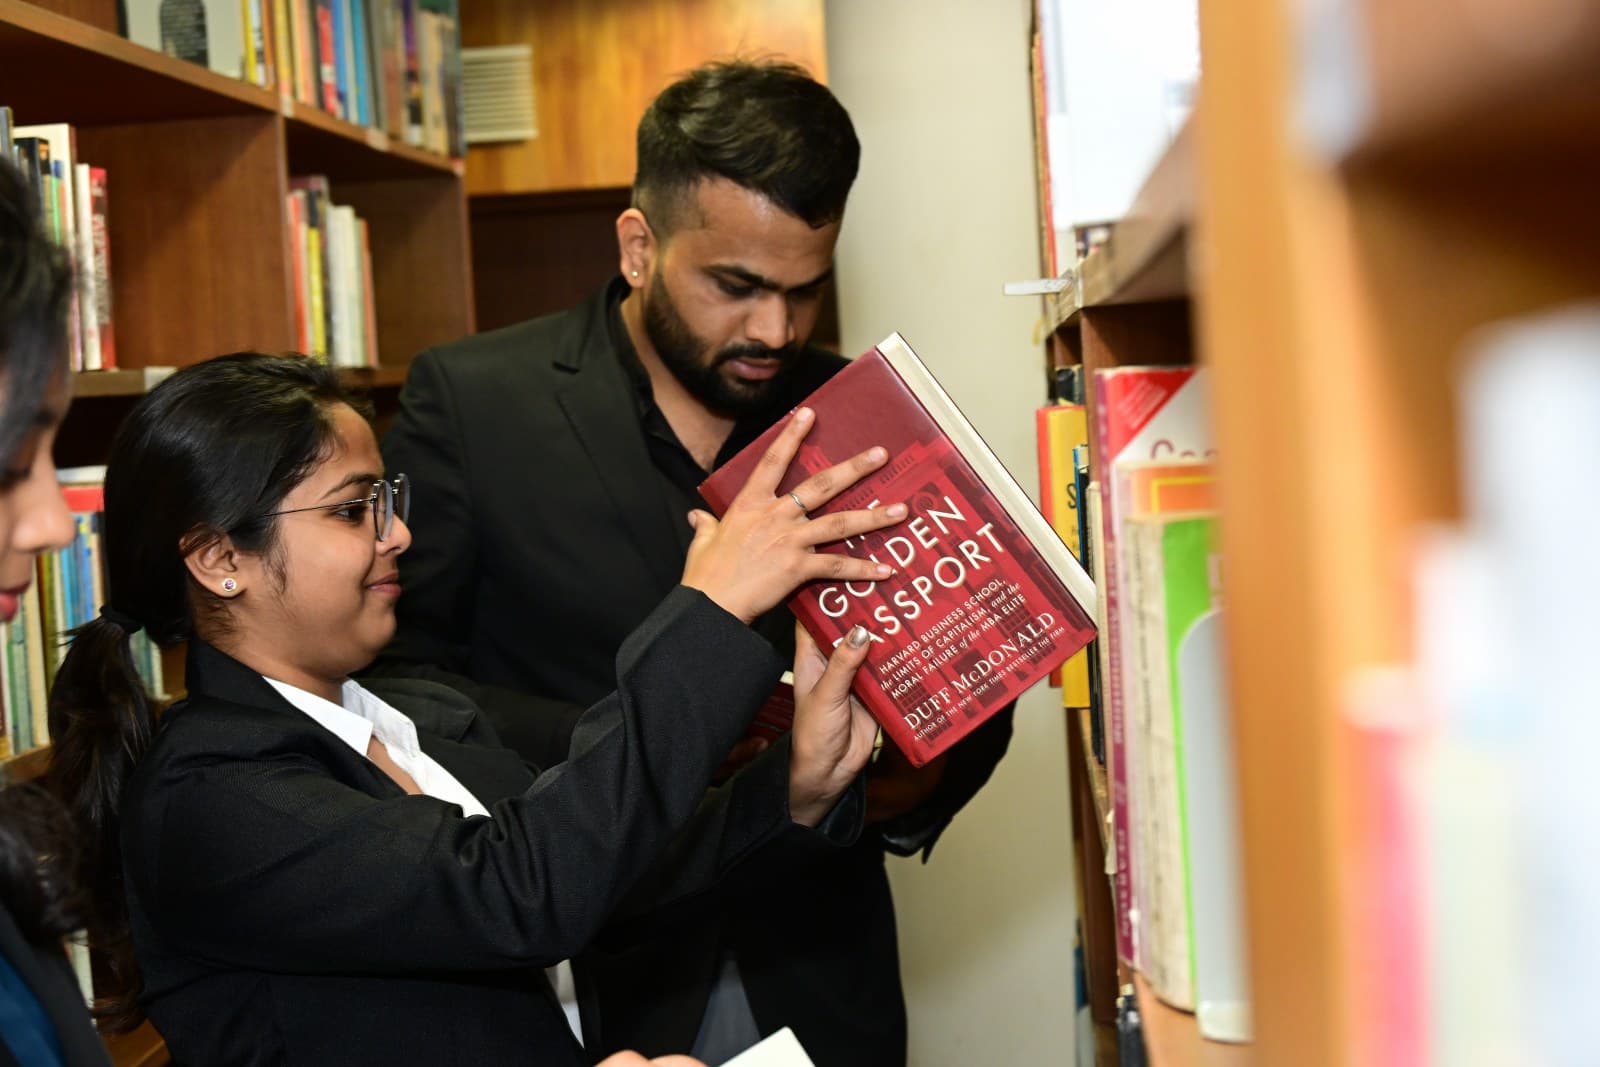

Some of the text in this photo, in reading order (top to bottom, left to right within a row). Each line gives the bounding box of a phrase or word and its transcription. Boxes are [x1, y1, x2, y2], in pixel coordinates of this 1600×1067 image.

[832, 522, 1005, 650] SSPORT
[879, 577, 1005, 674] HARVARD BUSINESS SCHOOL,
[880, 581, 1020, 690] the LIMITS OF CAPITALISM, and the
[890, 593, 1025, 698] MORAL FAILURE of the MBA ELITE
[904, 610, 1056, 730] DUFF McDONALD
[913, 722, 937, 742] AUTHOR
[936, 714, 946, 724] OF
[945, 706, 958, 716] THE
[958, 694, 972, 708] NEW
[988, 669, 1006, 684] TIMES
[1006, 646, 1038, 672] BESTSELLER
[1038, 636, 1050, 648] THE
[1050, 626, 1064, 639] FIRM
